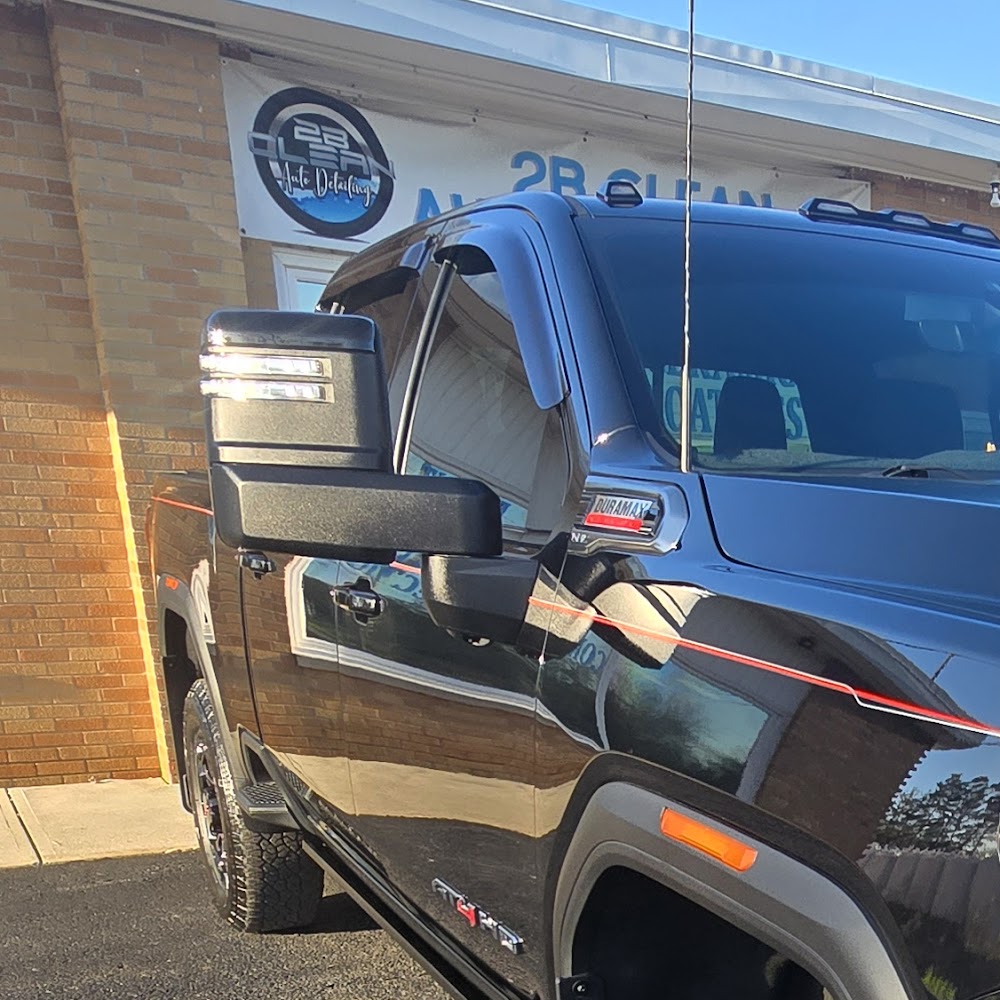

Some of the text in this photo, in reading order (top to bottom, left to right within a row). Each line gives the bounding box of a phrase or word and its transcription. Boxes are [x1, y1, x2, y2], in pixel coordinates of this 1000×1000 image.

[293, 117, 350, 150] 2B
[275, 161, 311, 195] Auto
[313, 167, 375, 208] Detailing
[595, 498, 648, 520] DURAMAX
